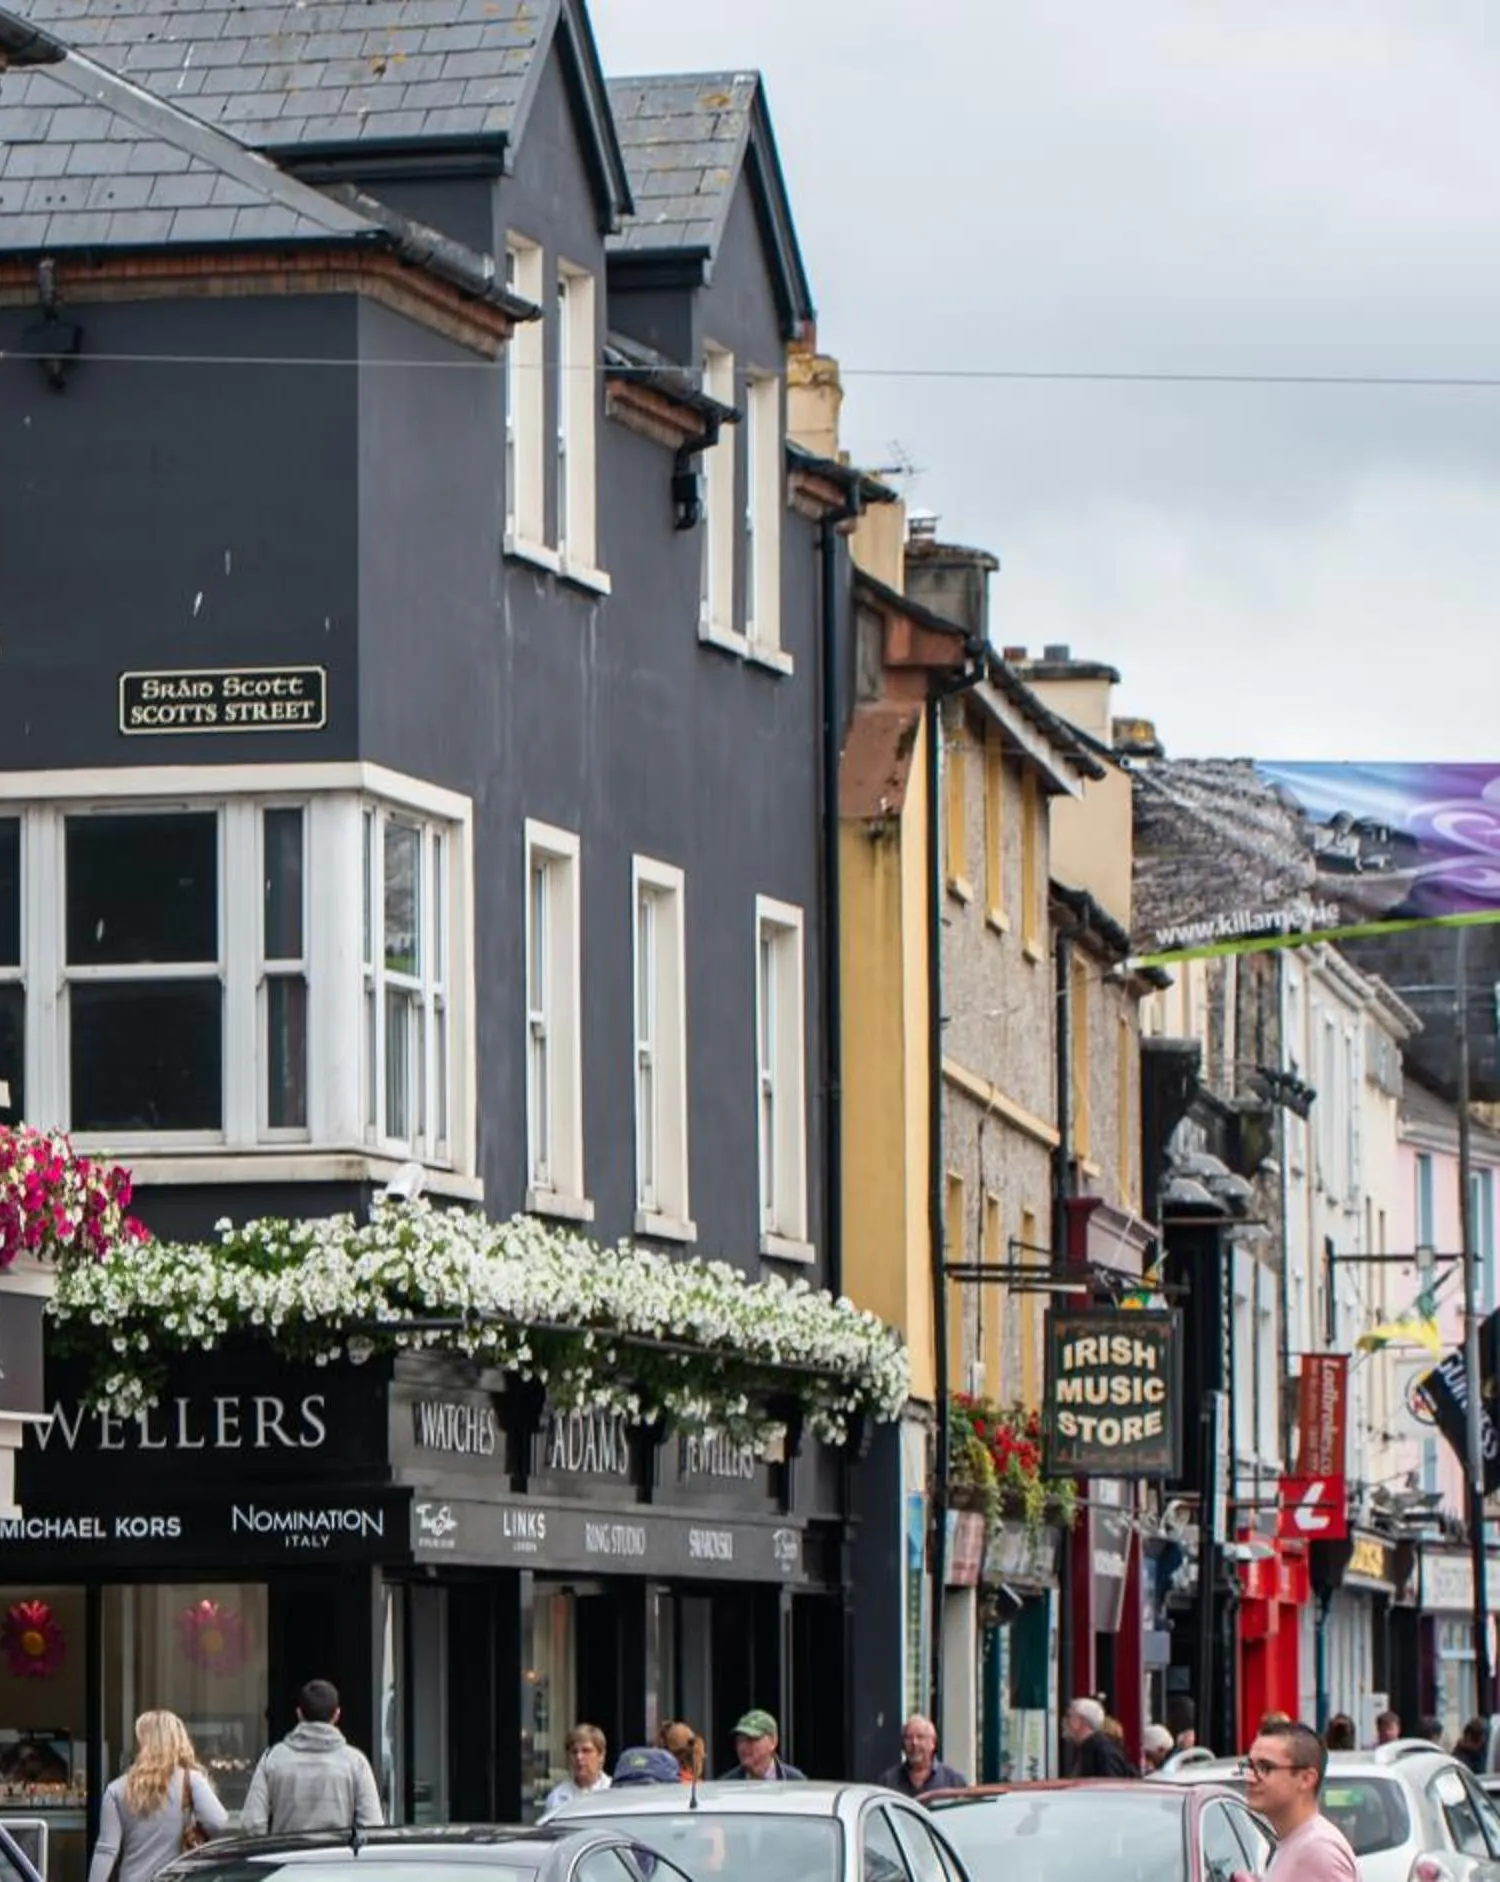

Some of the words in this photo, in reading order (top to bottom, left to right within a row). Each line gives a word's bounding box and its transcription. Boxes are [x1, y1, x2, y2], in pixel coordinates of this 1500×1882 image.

[222, 675, 304, 698] Scott
[130, 703, 218, 725] SCOTTS
[224, 700, 316, 722] STREET
[1063, 1335, 1156, 1371] IRISH
[1056, 1375, 1165, 1405] MUSIC
[421, 1401, 496, 1456] WATCHES
[551, 1409, 630, 1476] ADAMS
[1057, 1409, 1163, 1447] STORE
[0, 1518, 106, 1538] MICHAEL
[115, 1517, 181, 1538] KORS
[285, 1534, 330, 1547] ITALY
[503, 1511, 546, 1540] LINKS
[585, 1521, 611, 1553] RING
[611, 1524, 646, 1556] STUDIO
